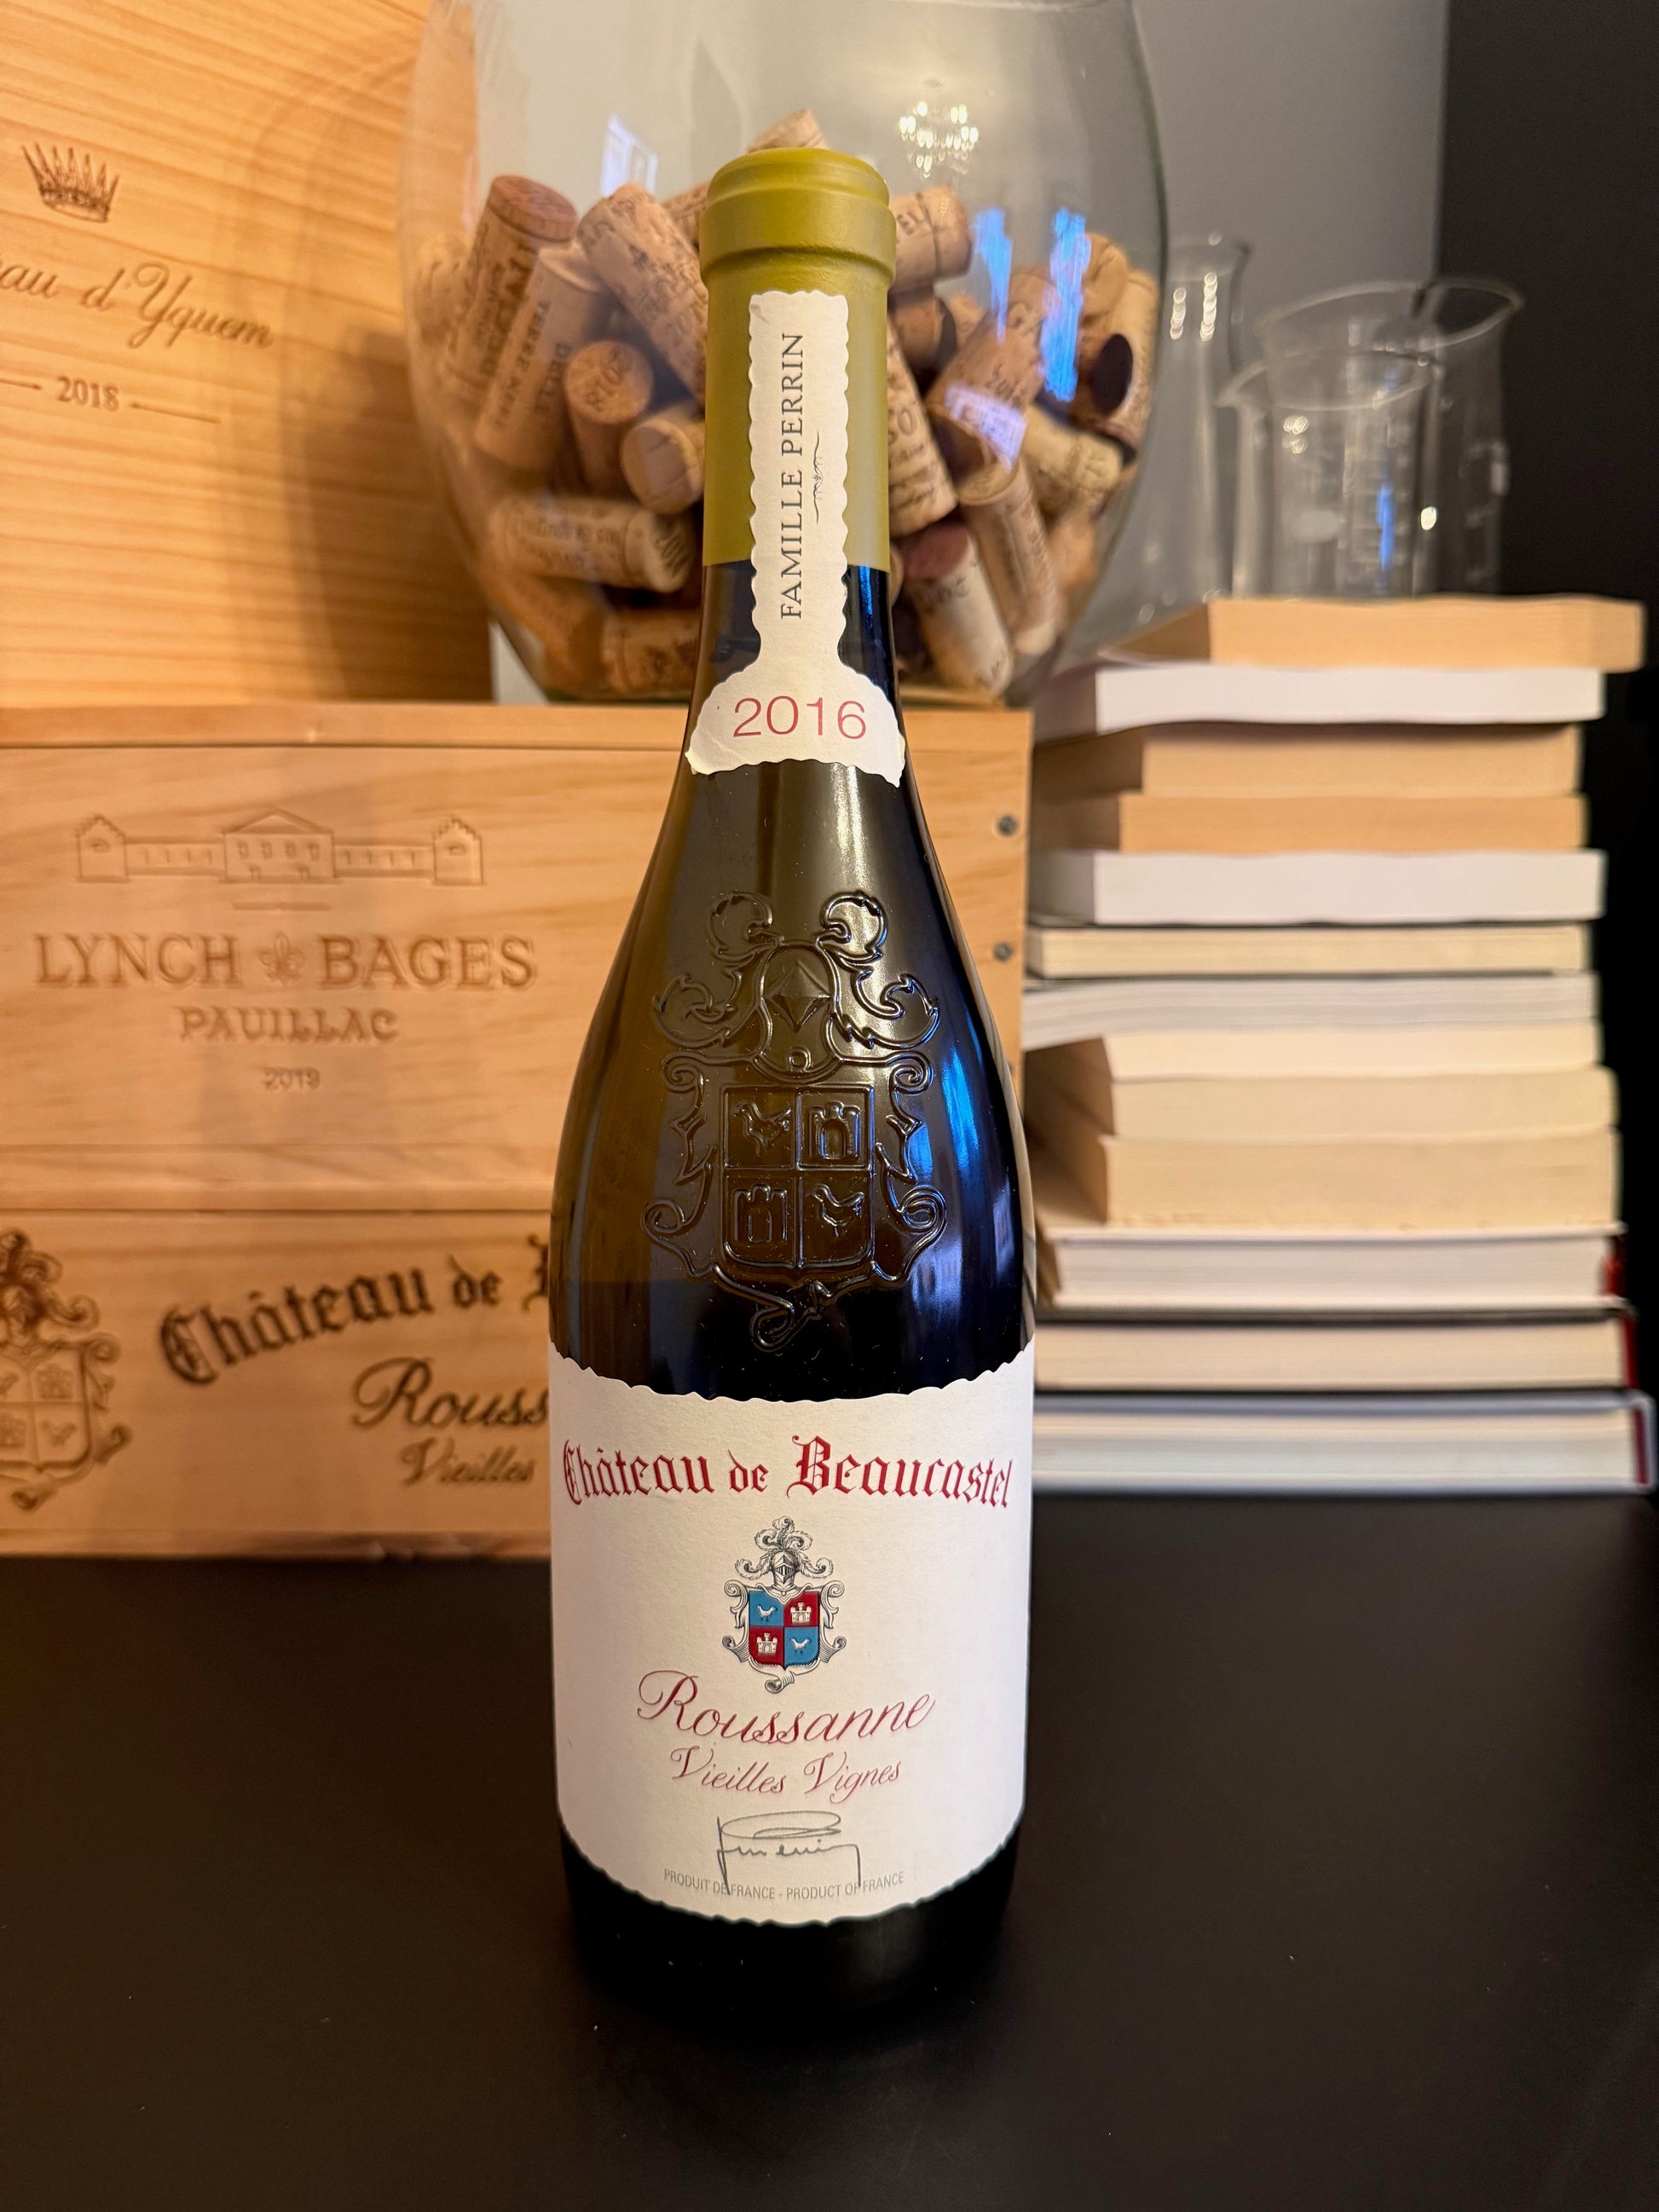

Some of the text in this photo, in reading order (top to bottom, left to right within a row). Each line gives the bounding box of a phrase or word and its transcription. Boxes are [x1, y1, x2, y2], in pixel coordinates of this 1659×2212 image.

[0, 258, 275, 349] au d'Yquem
[56, 375, 119, 412] 2018
[780, 332, 803, 620] FAMILLE PERRIN
[732, 695, 868, 739] 2016
[34, 932, 538, 992] LYNCH BAGES
[177, 1005, 400, 1044] PAUILLAC
[263, 1066, 321, 1091] 2019
[448, 1254, 503, 1309] de
[400, 1436, 535, 1487] Vieilles
[562, 1434, 1014, 1510] Château de Beaucastel
[636, 1669, 936, 1745] Roussanne
[669, 1743, 902, 1805] Vieilles Vignes
[663, 1868, 711, 1892] PRODUIT
[713, 1880, 727, 1896] DE
[730, 1883, 776, 1900] FRANCE
[785, 1883, 841, 1901] PRODUCT
[844, 1881, 860, 1897] OF
[862, 1870, 905, 1893] FRANCE
